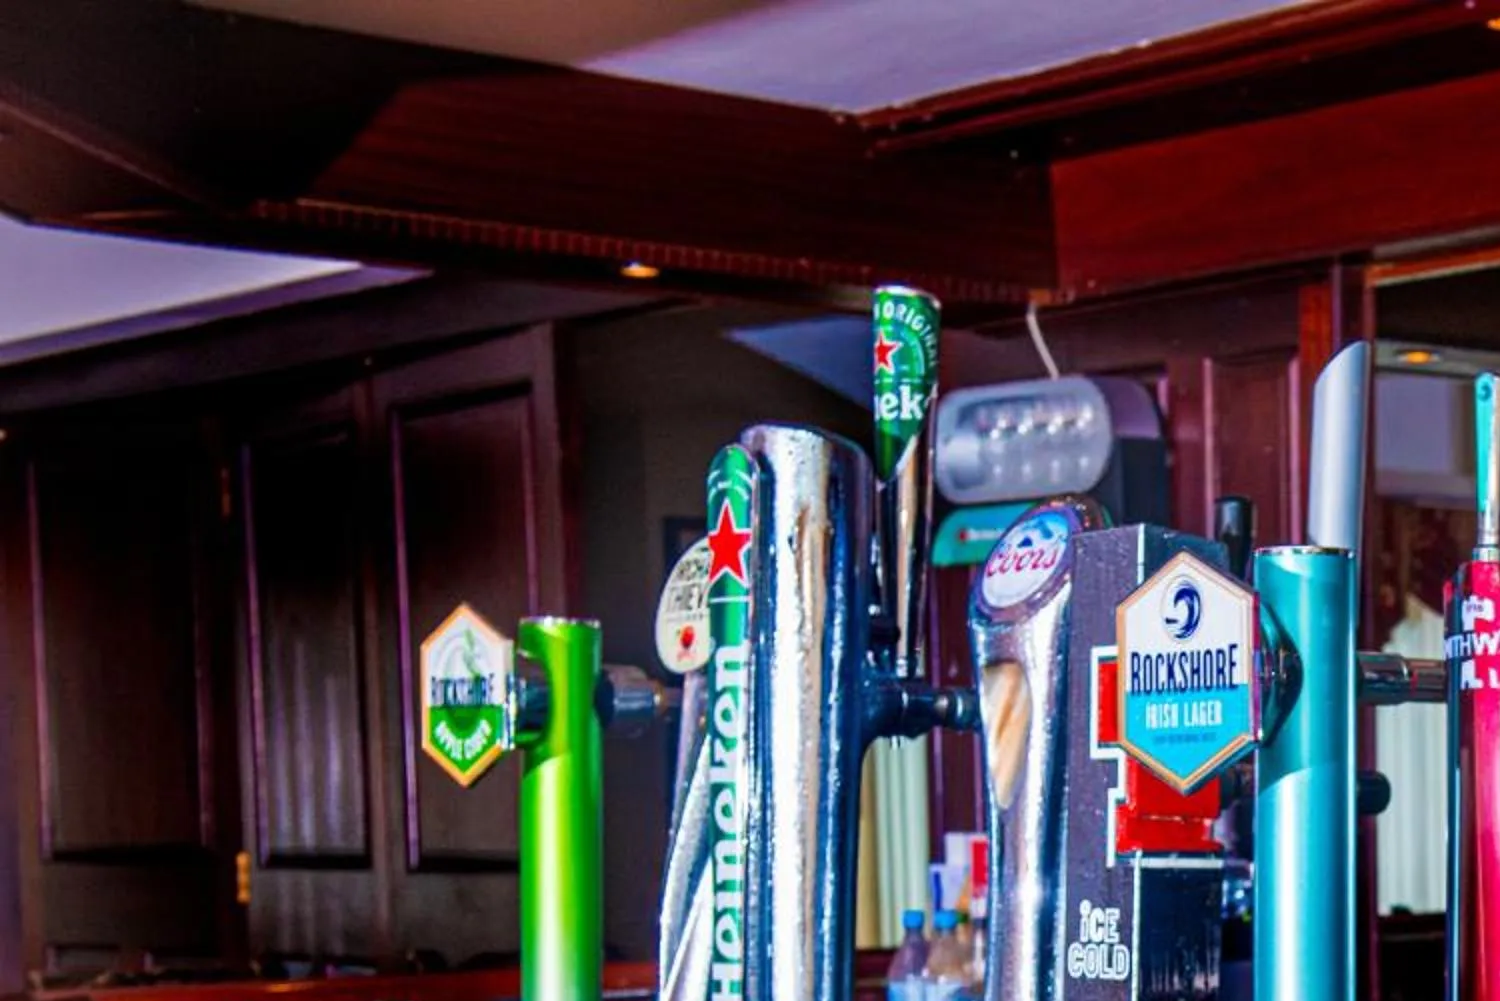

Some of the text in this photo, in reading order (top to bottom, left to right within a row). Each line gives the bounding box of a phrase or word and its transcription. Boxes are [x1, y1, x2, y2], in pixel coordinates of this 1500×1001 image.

[986, 548, 1060, 577] Coors
[1130, 643, 1239, 695] ROCKSHORE
[1183, 699, 1224, 727] LAGER
[1067, 942, 1131, 980] COLD
